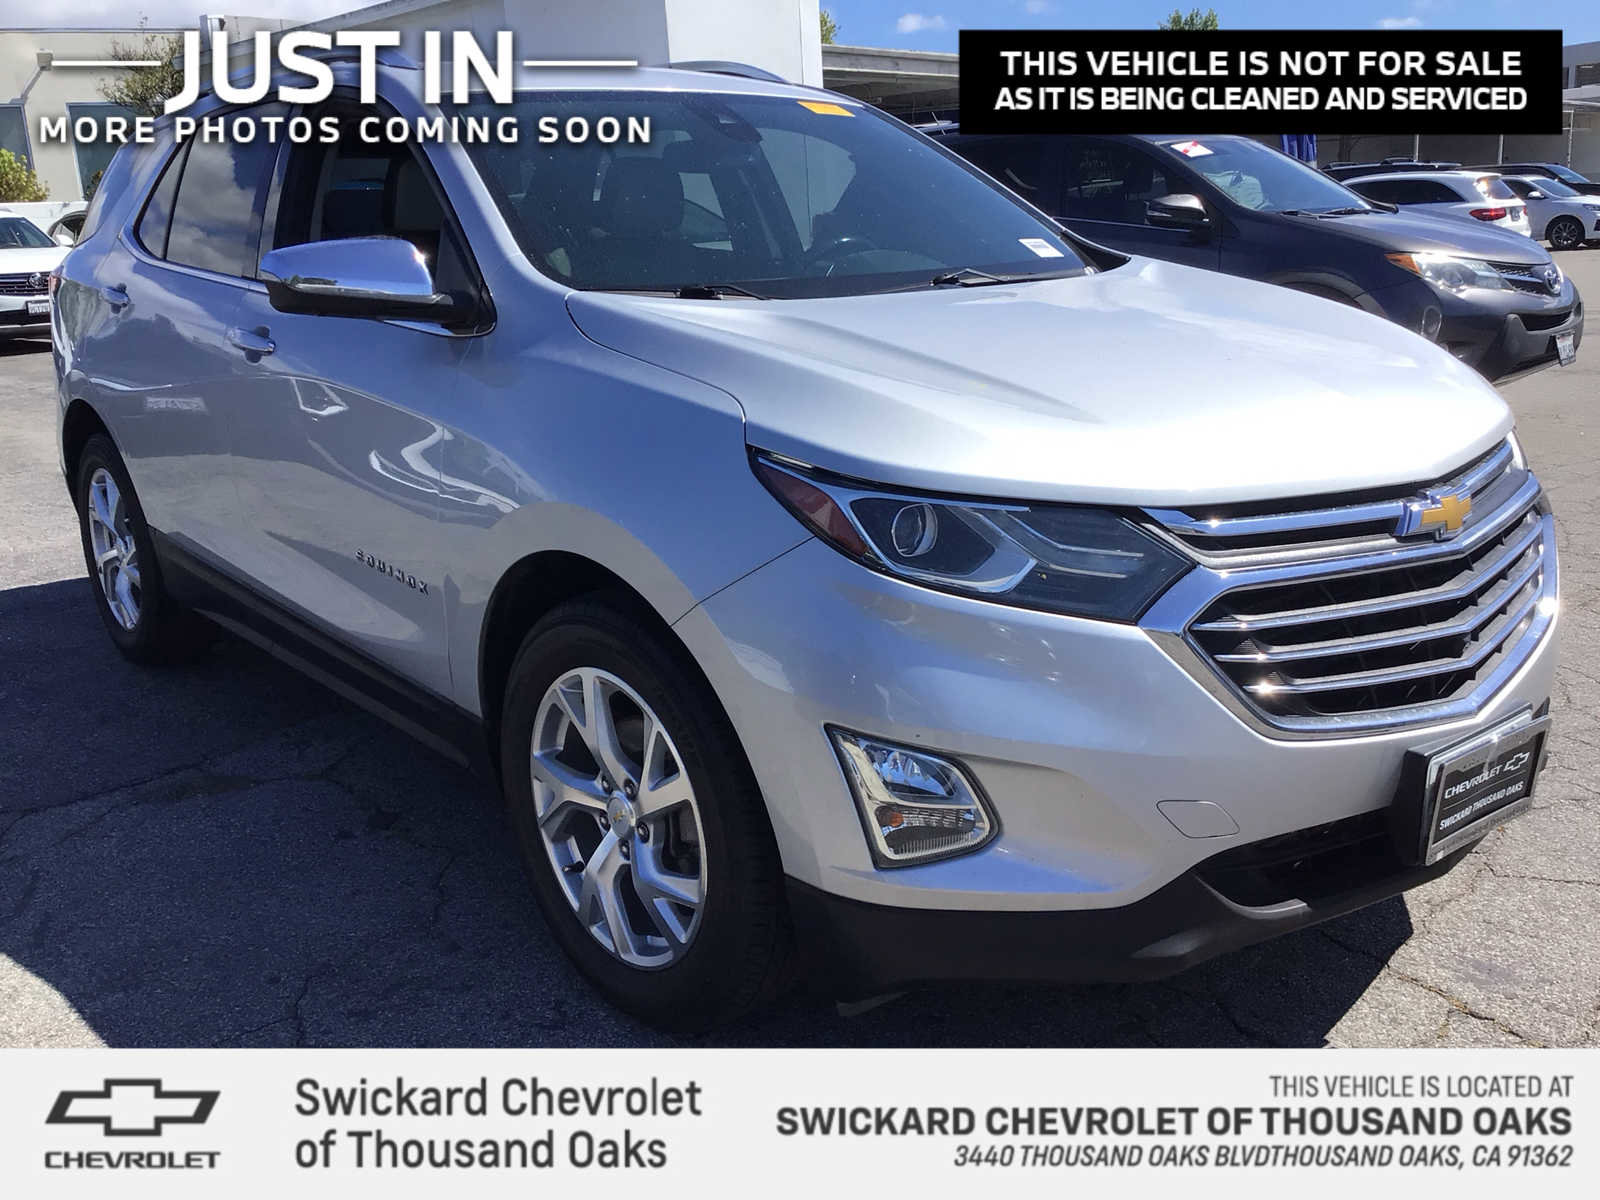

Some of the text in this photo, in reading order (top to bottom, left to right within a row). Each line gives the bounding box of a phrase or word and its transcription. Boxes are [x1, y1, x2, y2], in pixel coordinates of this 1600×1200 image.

[356, 548, 429, 596] EQUINOX
[1440, 781, 1524, 830] SWICKARD THOUSAND OAKS
[1444, 765, 1502, 799] CHEVROLET
